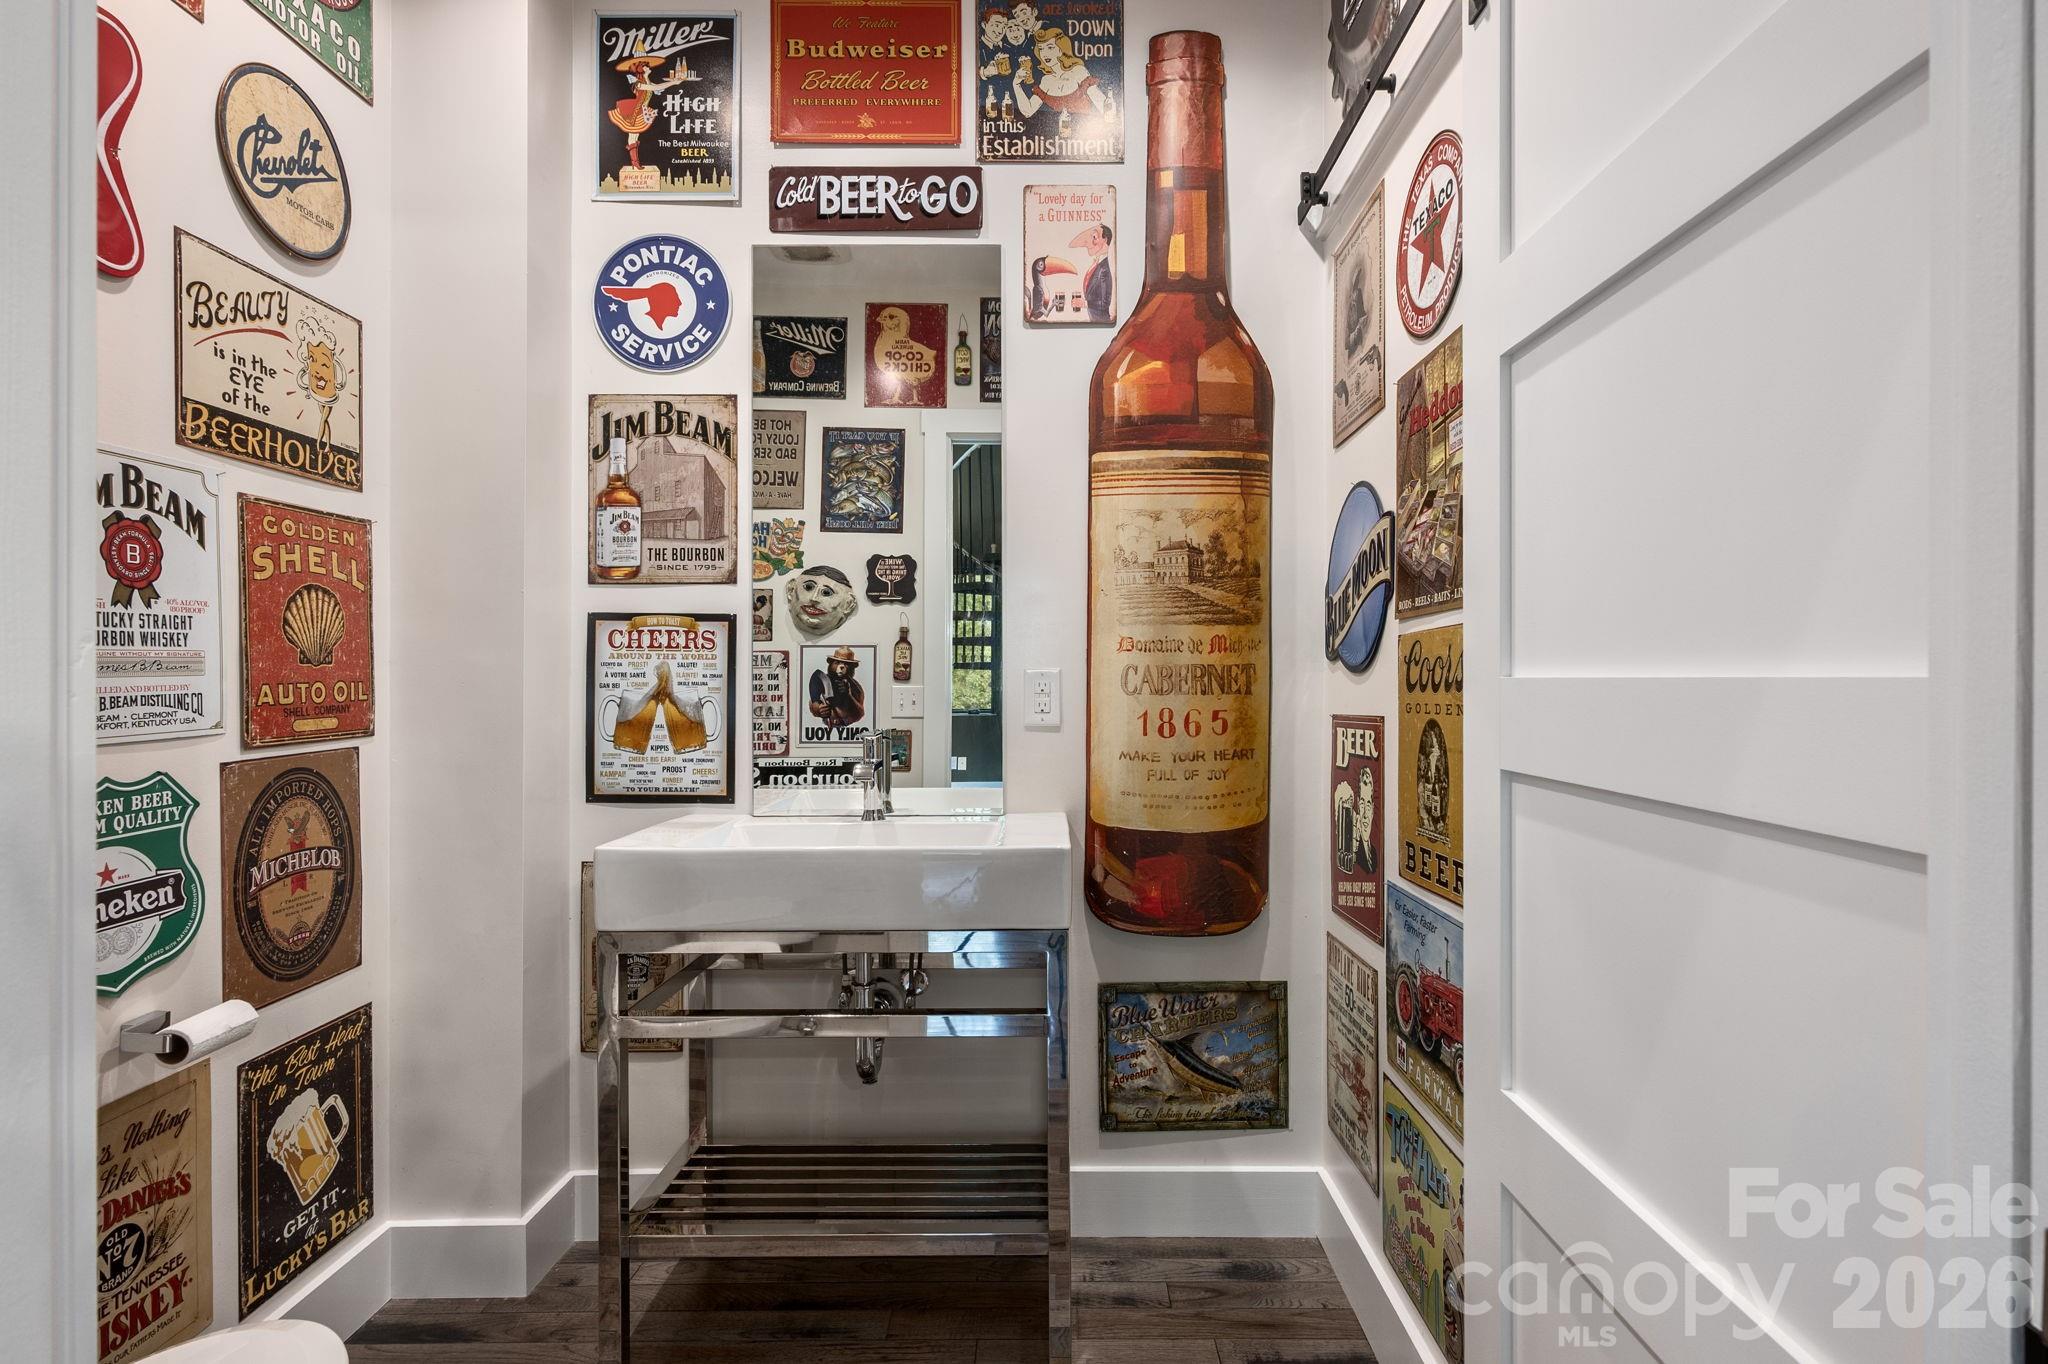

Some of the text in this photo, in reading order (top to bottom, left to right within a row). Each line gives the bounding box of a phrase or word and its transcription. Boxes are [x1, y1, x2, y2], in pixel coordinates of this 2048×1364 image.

[832, 16, 900, 30] We Feature
[1067, 19, 1115, 37] DOWN
[603, 20, 730, 62] Miller
[786, 38, 948, 59] Budweiser
[1074, 40, 1113, 60] Upon
[336, 52, 362, 87] OIL
[801, 69, 930, 91] Bottled Beer
[663, 89, 721, 113] HIGH
[793, 98, 942, 106] PREFERRED EVERYWHERE
[664, 111, 717, 134] LIFE
[983, 118, 1025, 134] in this
[237, 113, 338, 199] Chevrolet
[658, 139, 730, 148] The Best Milwaukee
[681, 148, 709, 157] BEER
[982, 135, 1117, 157] Establishment
[1410, 155, 1434, 203] TEXAS
[775, 175, 978, 221] Cold BEER to GO
[1070, 193, 1104, 207] day for
[1413, 178, 1454, 236] TEXACO
[286, 197, 335, 231] MOTOR CARS
[1039, 213, 1044, 221] a
[1401, 217, 1412, 253] THE
[609, 245, 713, 286] PONTIAC
[646, 271, 680, 279] AUTHORIZED
[186, 281, 289, 329] BEAUTY
[1400, 282, 1433, 330] PETROLEUM
[611, 323, 712, 363] SERVICE
[213, 342, 278, 379] is in the
[229, 367, 264, 393] EYE
[222, 391, 271, 416] of the
[185, 402, 358, 484] BEERHOLDER
[592, 400, 732, 461] JIM BEAM
[119, 462, 206, 552] BEAM
[263, 515, 355, 547] GOLDEN
[612, 536, 638, 544] BOURBON
[126, 544, 140, 564] B
[647, 547, 725, 562] THE BOURBON
[1351, 527, 1389, 602] MOON
[252, 543, 365, 592] SHELL
[139, 613, 193, 630] STRAIGHT
[140, 631, 188, 647] WHISKEY
[607, 629, 717, 651] CHEERS
[1115, 636, 1203, 655] Domaine de
[608, 652, 718, 661] AROUND THE WORLD
[256, 680, 369, 706] AUTO OIL
[1120, 663, 1257, 697] CABERNET
[109, 695, 138, 710] BEAM
[140, 693, 189, 711] DISTILLING
[283, 703, 351, 719] SHELL COMPANY
[130, 711, 178, 720] CLERMONT
[131, 719, 178, 728] KENTUCKY
[1136, 707, 1230, 739] 1865
[1118, 747, 1256, 762] MAKE YOUR HEART
[1336, 727, 1379, 767] BEER
[1146, 768, 1231, 782] FULL OF JOY
[131, 790, 173, 811] BEER
[114, 806, 182, 834] QUALITY
[249, 824, 265, 857] ALL
[262, 782, 324, 819] IMPORTED
[322, 799, 342, 837] HOPS
[249, 848, 341, 894] MICHELOB
[1405, 841, 1463, 895] BEER
[1111, 994, 1219, 1028] Blue Water
[1115, 1005, 1238, 1044] CHARTERS
[285, 1015, 366, 1075] Best Head
[1114, 1049, 1147, 1063] Escape
[1112, 1066, 1158, 1087] Adventure
[268, 1082, 287, 1106] in
[123, 1108, 191, 1153] Nothing
[101, 1171, 191, 1232] DANIEL'S
[283, 1201, 320, 1239] GET
[322, 1191, 338, 1211] IT
[106, 1229, 128, 1247] OLD
[305, 1217, 319, 1240] at
[245, 1199, 369, 1306] LUCKY'S BAR
[101, 1266, 133, 1292] BRAND
[111, 1251, 187, 1309] TENNESSEE
